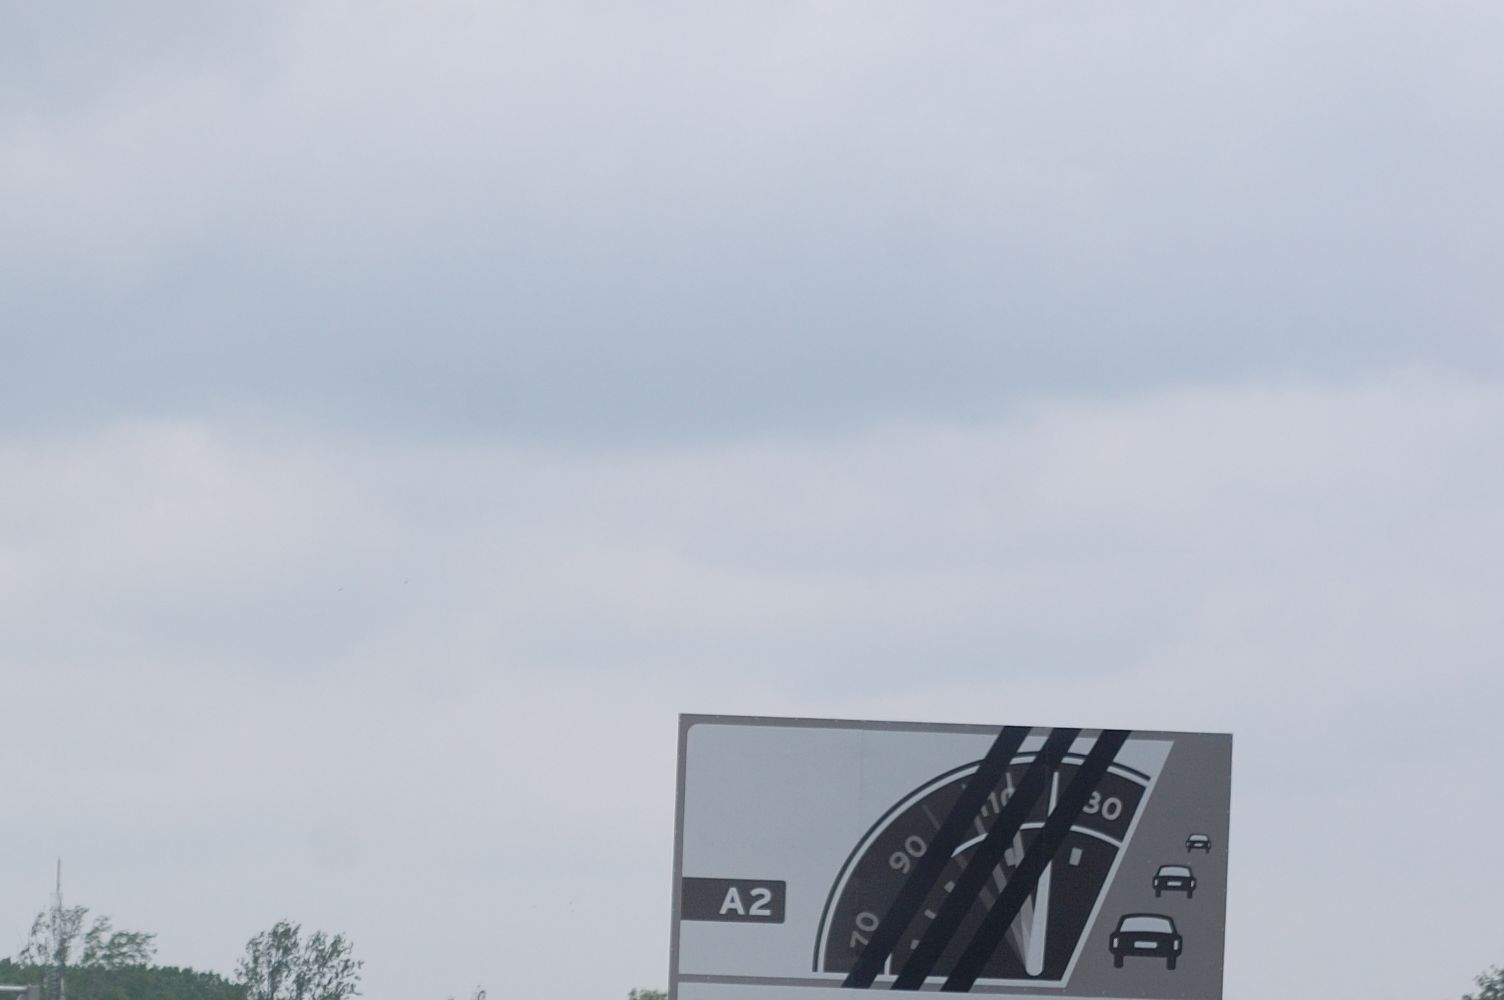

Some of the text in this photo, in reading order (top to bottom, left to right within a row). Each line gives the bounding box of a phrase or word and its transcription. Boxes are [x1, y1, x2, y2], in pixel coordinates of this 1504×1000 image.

[888, 835, 927, 875] 90
[718, 887, 772, 917] A2
[849, 911, 879, 949] 70
